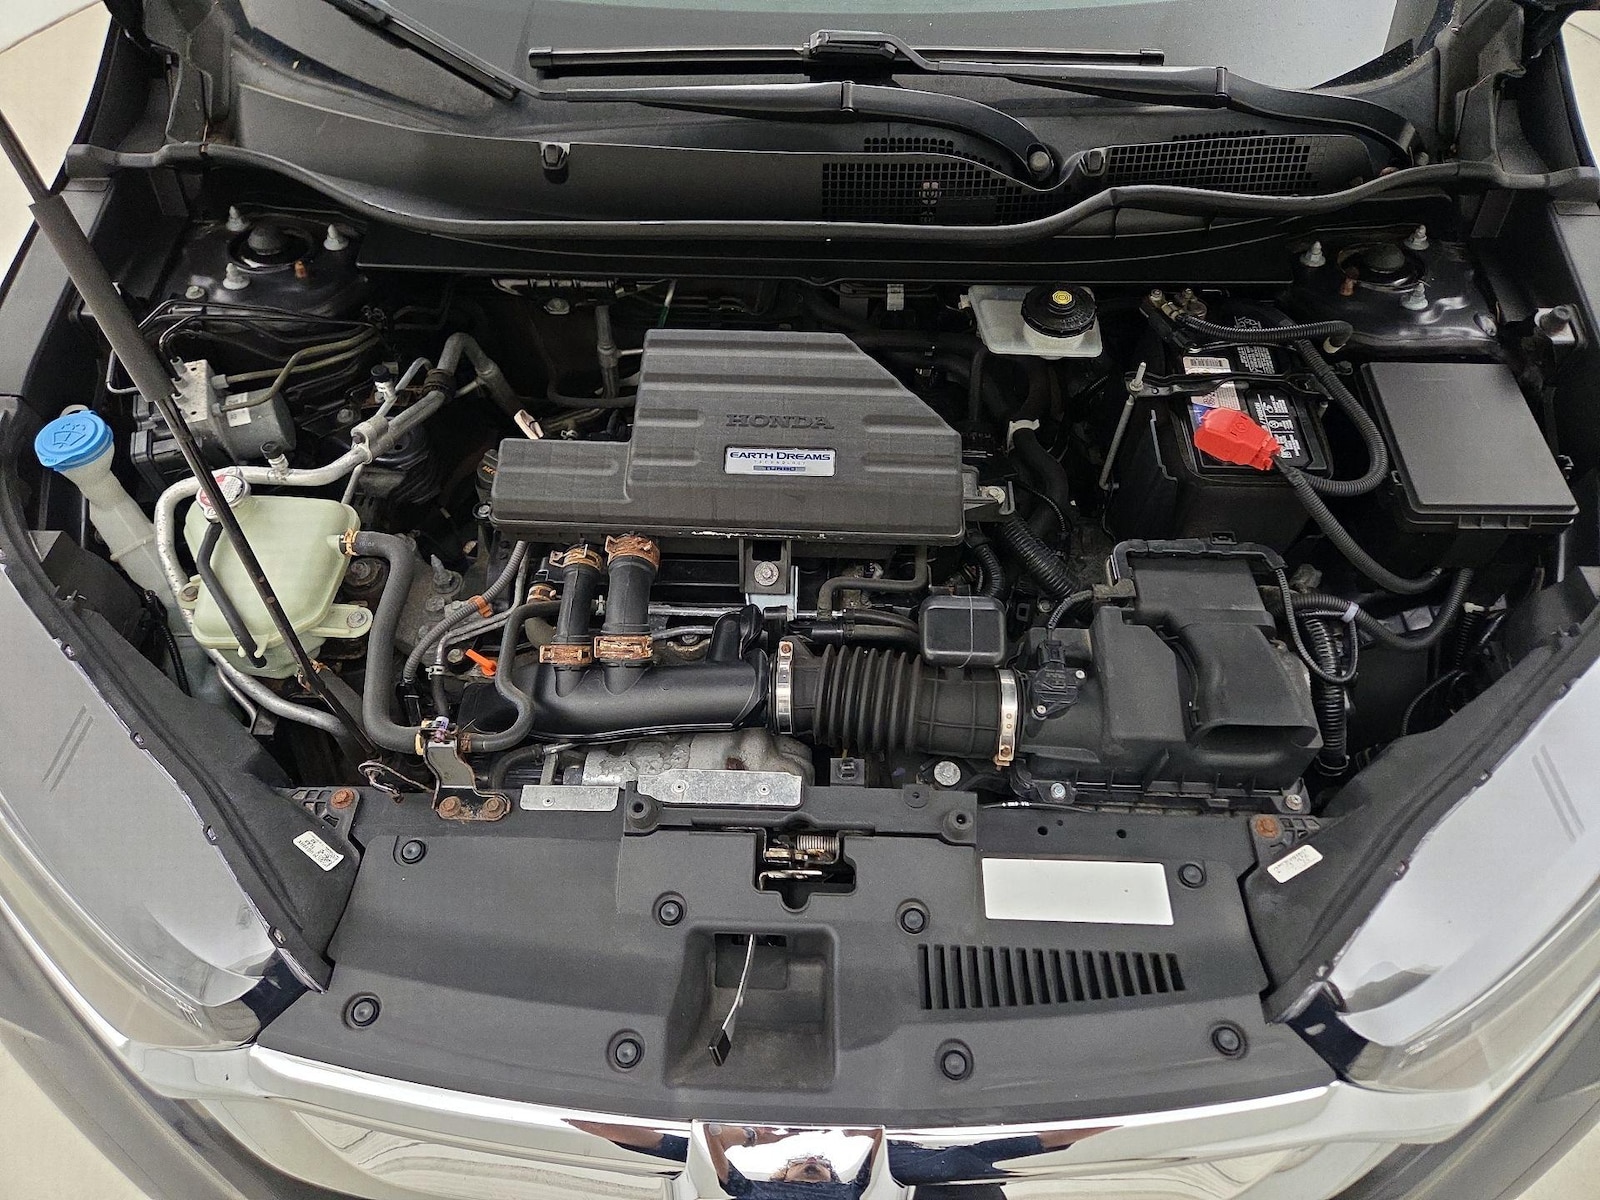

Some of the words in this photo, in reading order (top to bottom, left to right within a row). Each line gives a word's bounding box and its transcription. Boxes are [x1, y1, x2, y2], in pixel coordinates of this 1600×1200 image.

[725, 413, 835, 430] HONDA
[729, 451, 774, 460] EARTH
[776, 451, 831, 461] DREAMS
